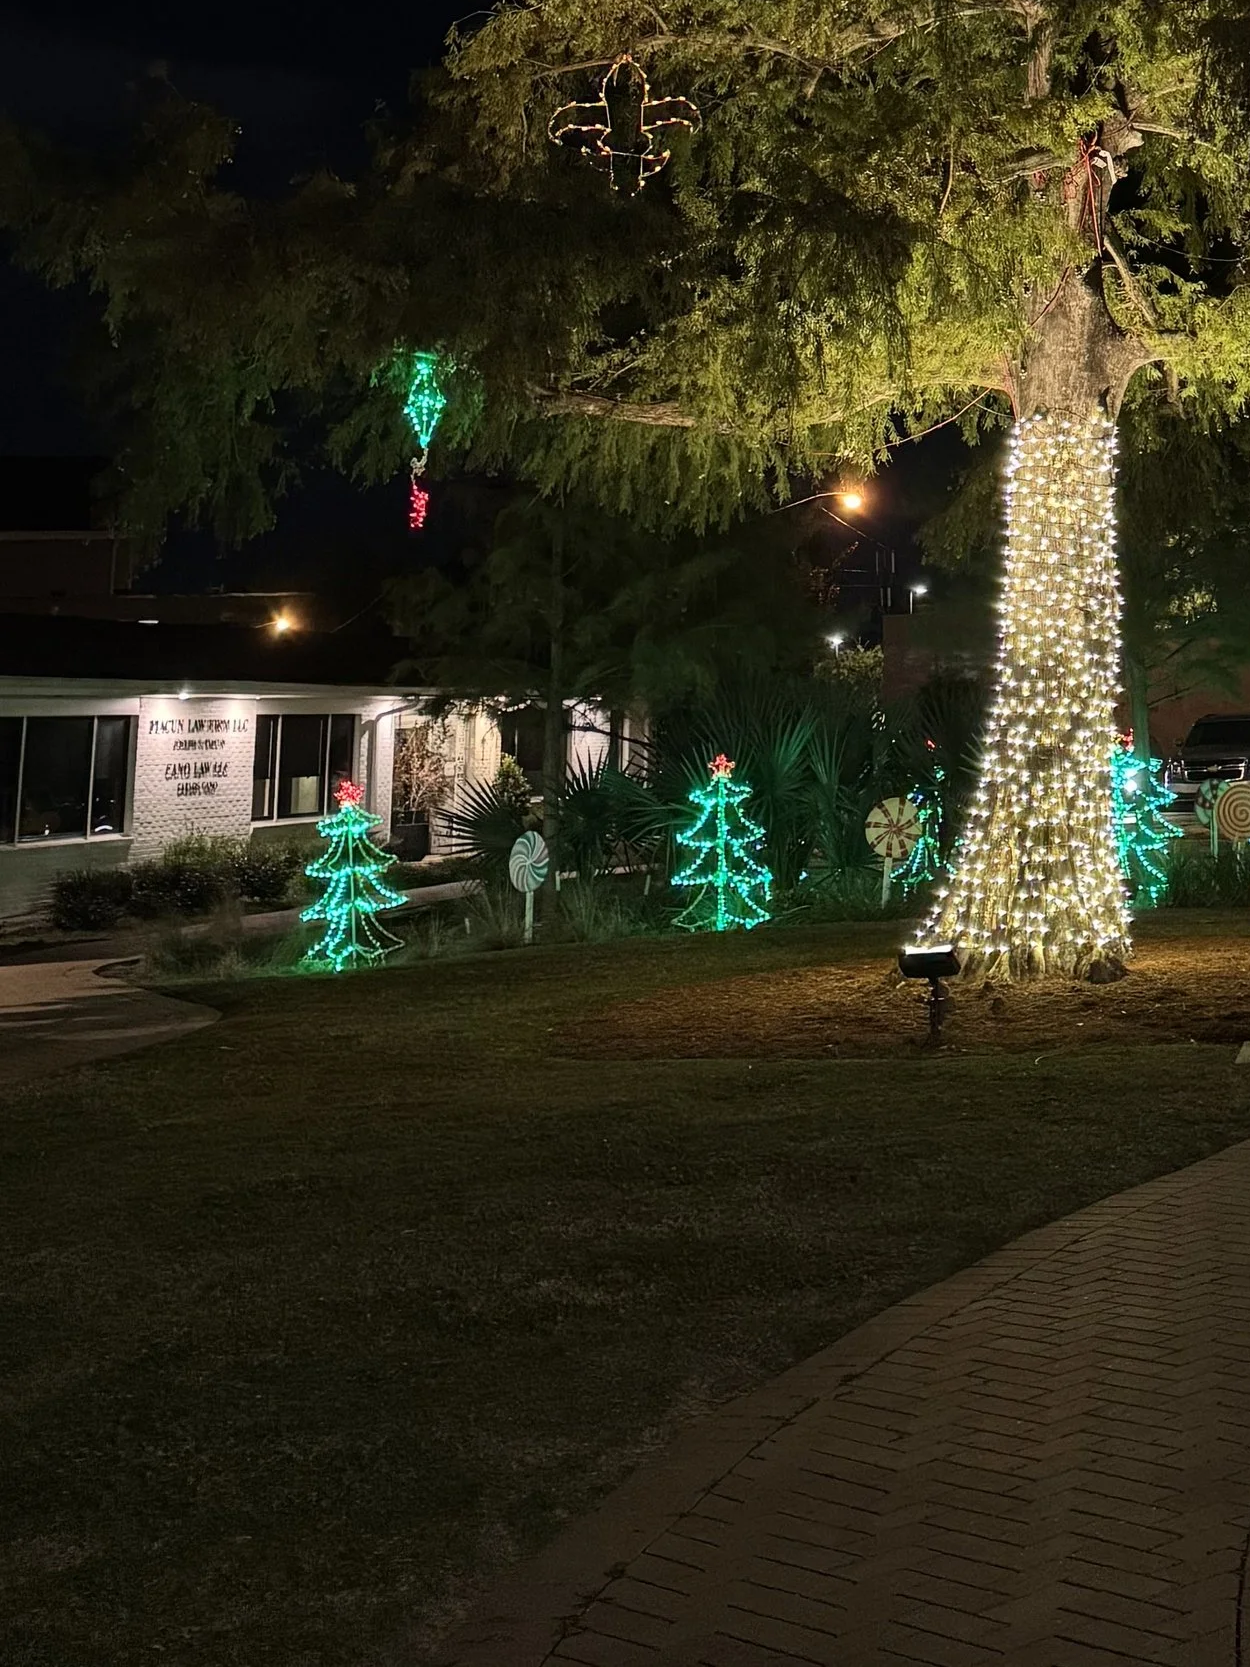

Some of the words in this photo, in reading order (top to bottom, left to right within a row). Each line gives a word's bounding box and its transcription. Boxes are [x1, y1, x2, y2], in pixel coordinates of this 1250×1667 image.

[188, 718, 207, 733] LAW
[232, 718, 249, 733] LLC
[193, 761, 211, 779] LAW
